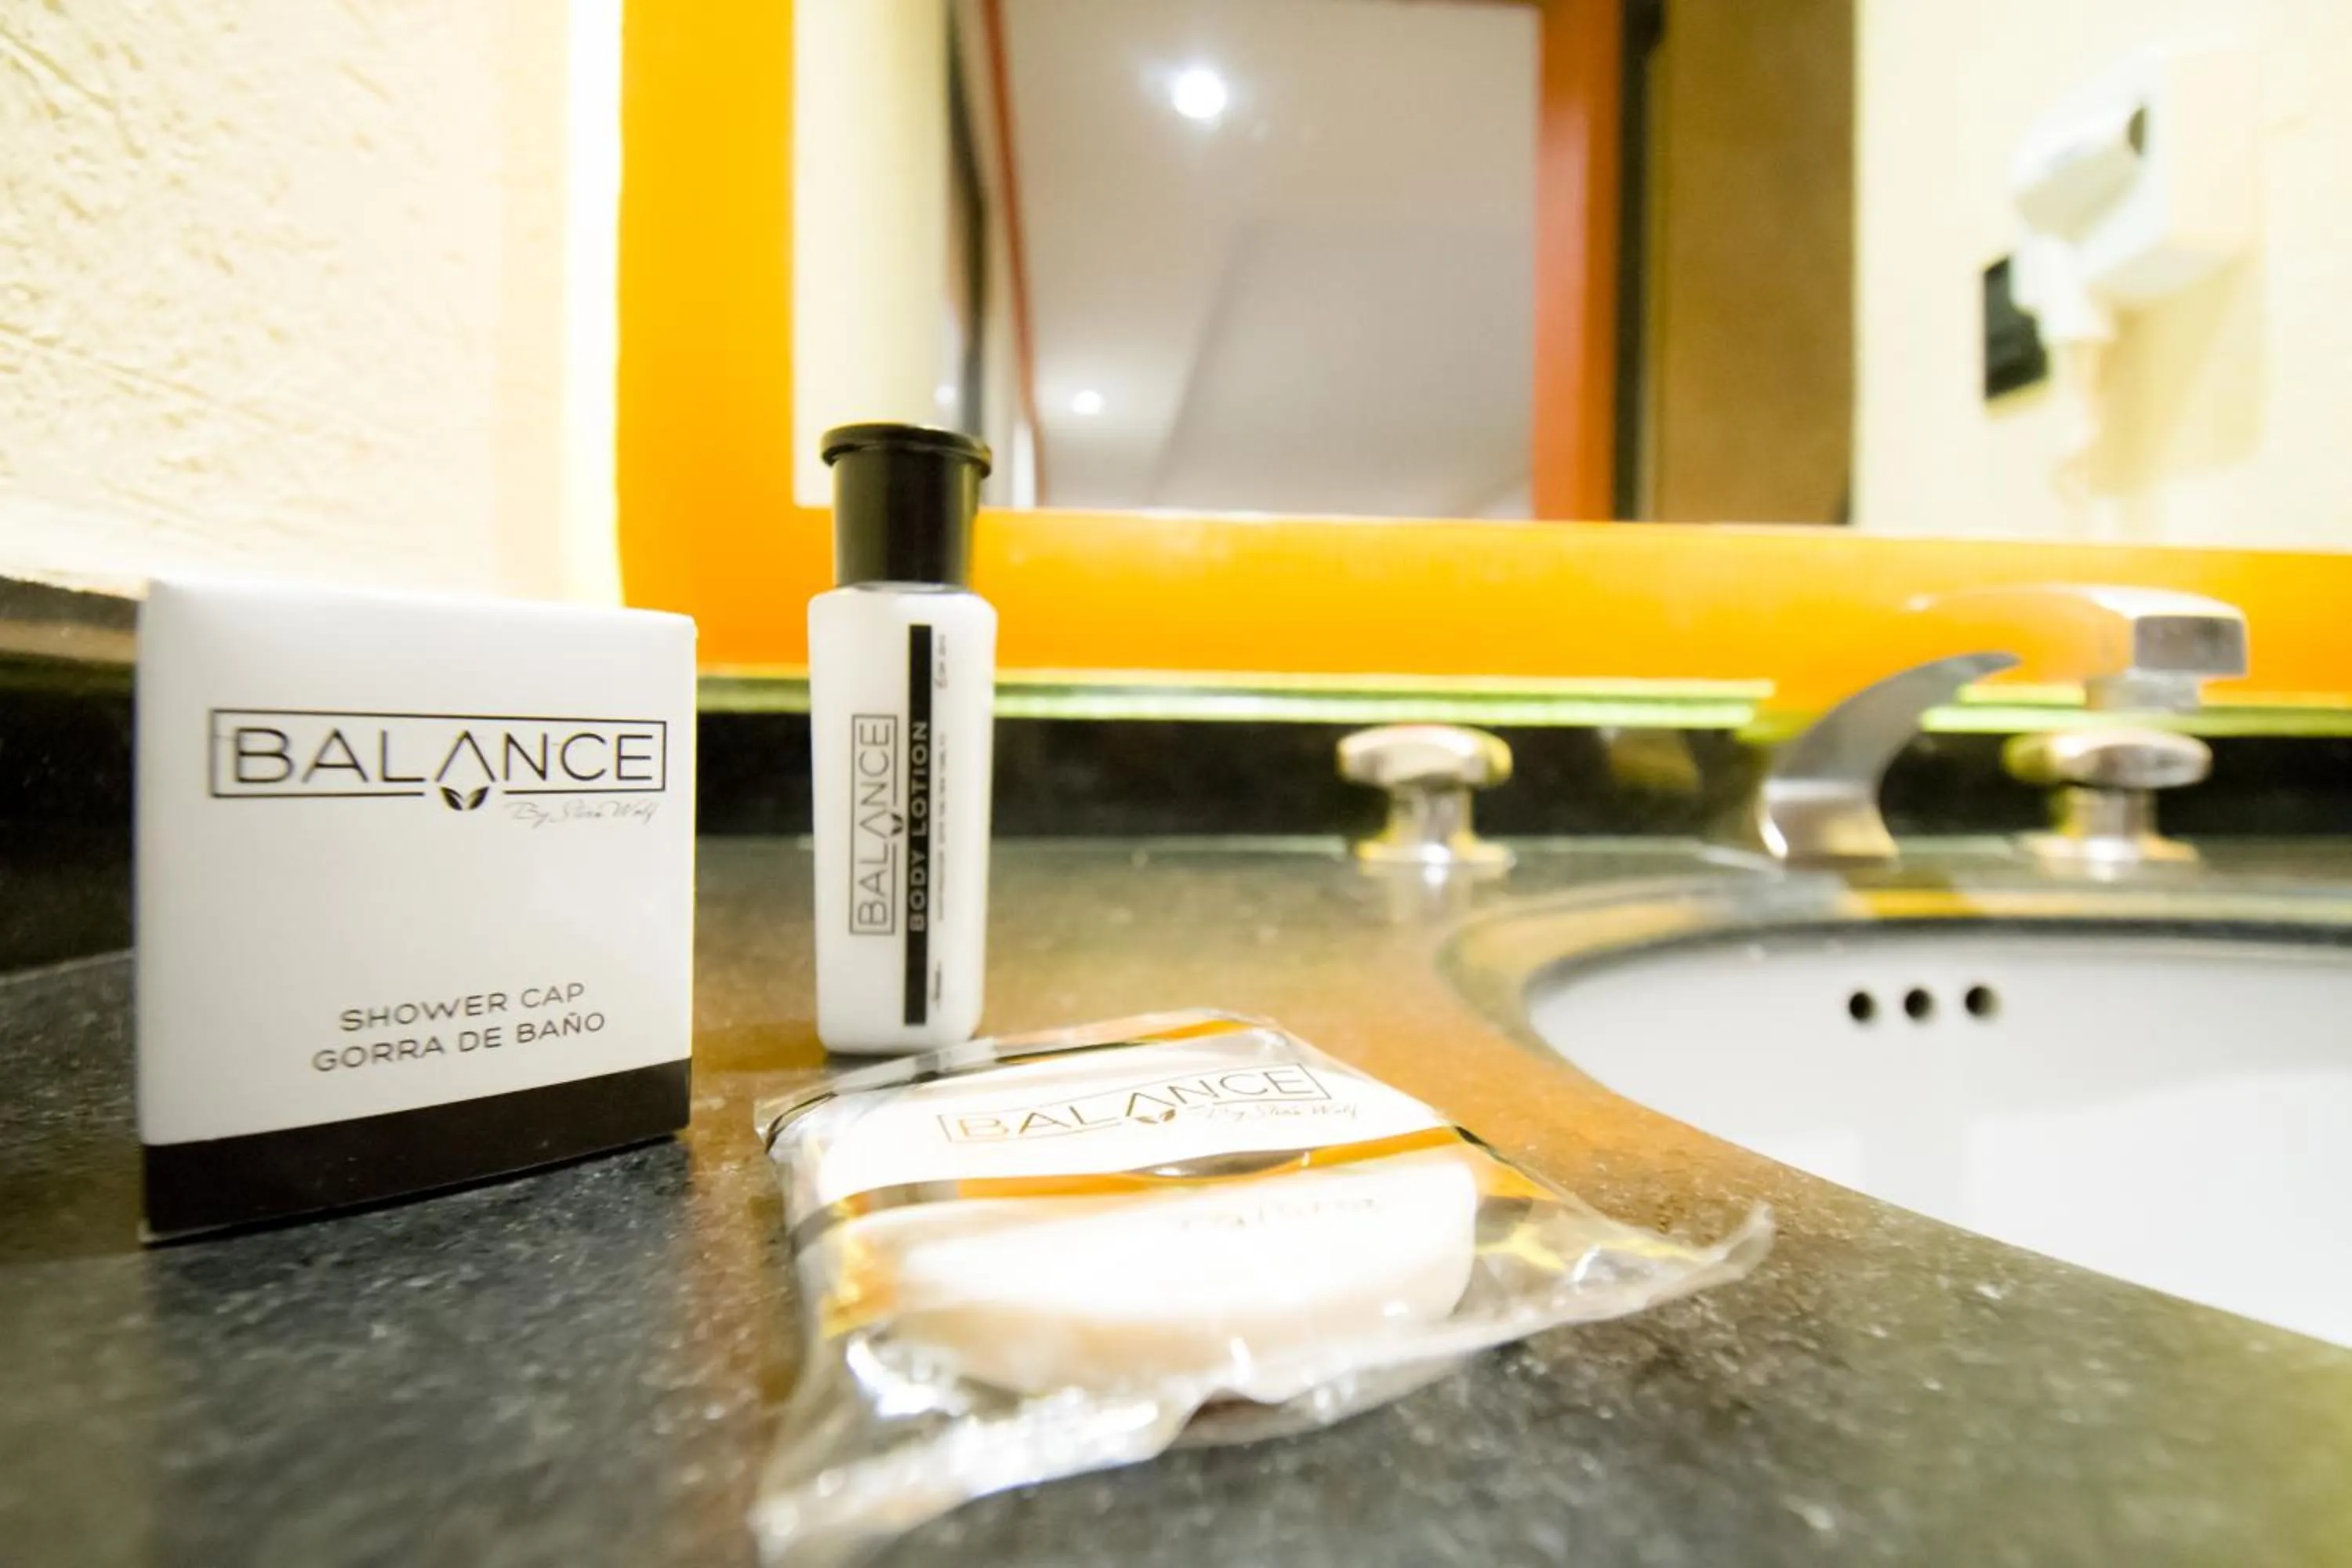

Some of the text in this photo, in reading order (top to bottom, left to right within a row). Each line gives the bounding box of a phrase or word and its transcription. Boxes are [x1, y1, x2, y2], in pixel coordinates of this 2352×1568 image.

[234, 728, 654, 784] BALANCE
[858, 723, 890, 926] BALANCE
[909, 720, 929, 932] BODY LOTION
[339, 982, 586, 1032] SHOWER CAP
[313, 1011, 607, 1072] GORRA DE BAÑO
[957, 1071, 1313, 1138] BALANCE
